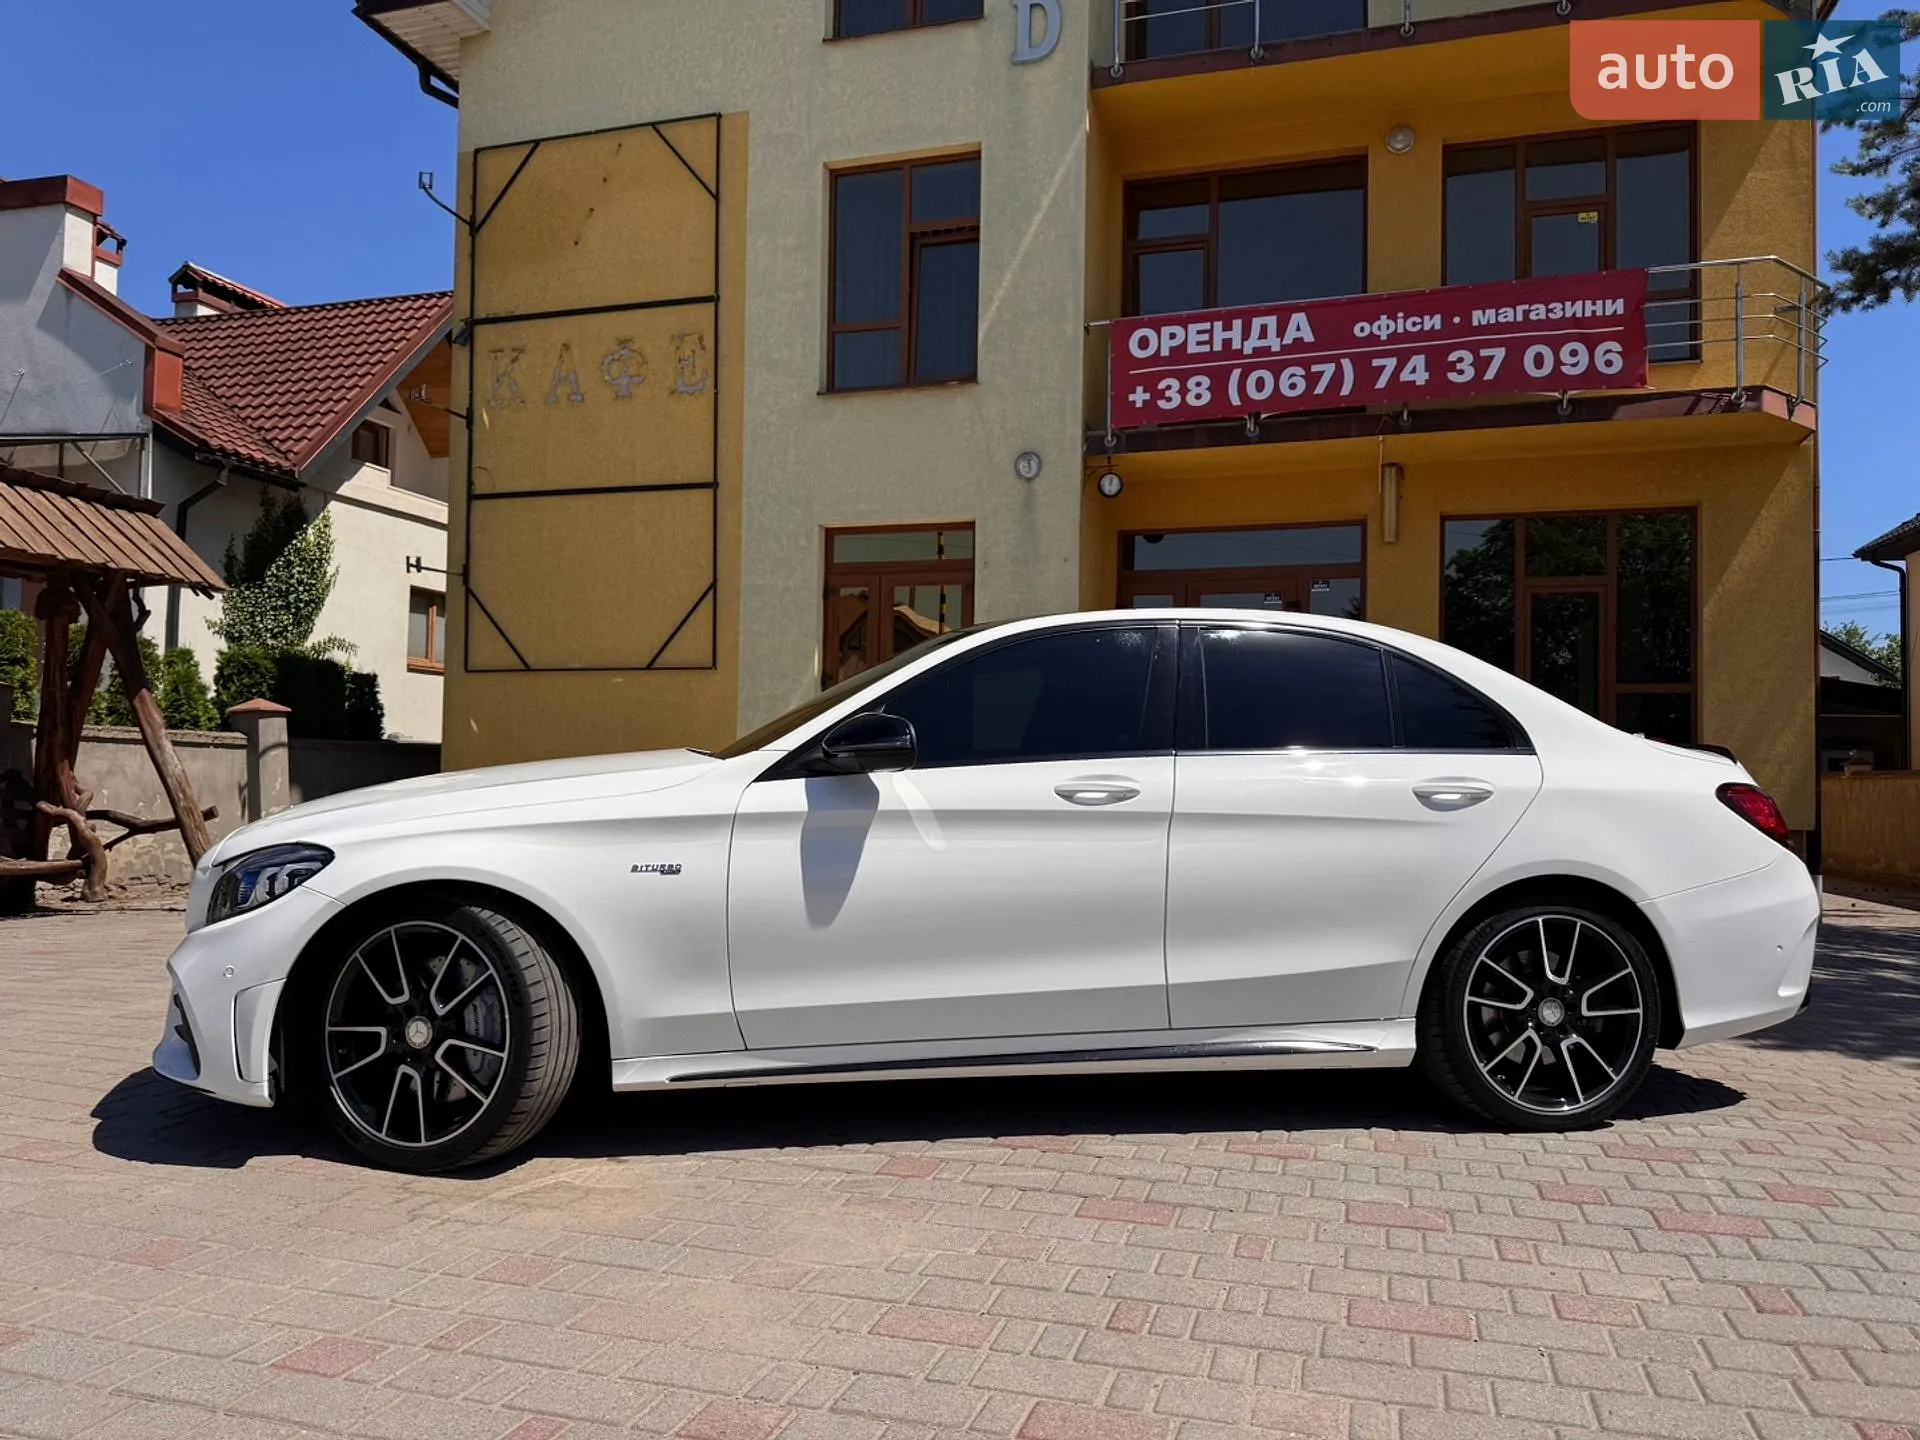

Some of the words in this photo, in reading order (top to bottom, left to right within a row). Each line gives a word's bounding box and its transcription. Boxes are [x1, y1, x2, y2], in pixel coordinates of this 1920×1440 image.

[1011, 0, 1062, 65] D
[1128, 312, 1315, 359] ОРЕНДА
[1353, 313, 1442, 341] офіси
[1471, 298, 1625, 327] магазини
[487, 332, 708, 407] КАФЕ
[1127, 375, 1212, 410] +38
[1228, 357, 1354, 407] (067)
[1370, 354, 1429, 390] 74
[1446, 347, 1507, 384] 37
[1522, 340, 1625, 378] 096
[630, 863, 683, 874] BITURBO
